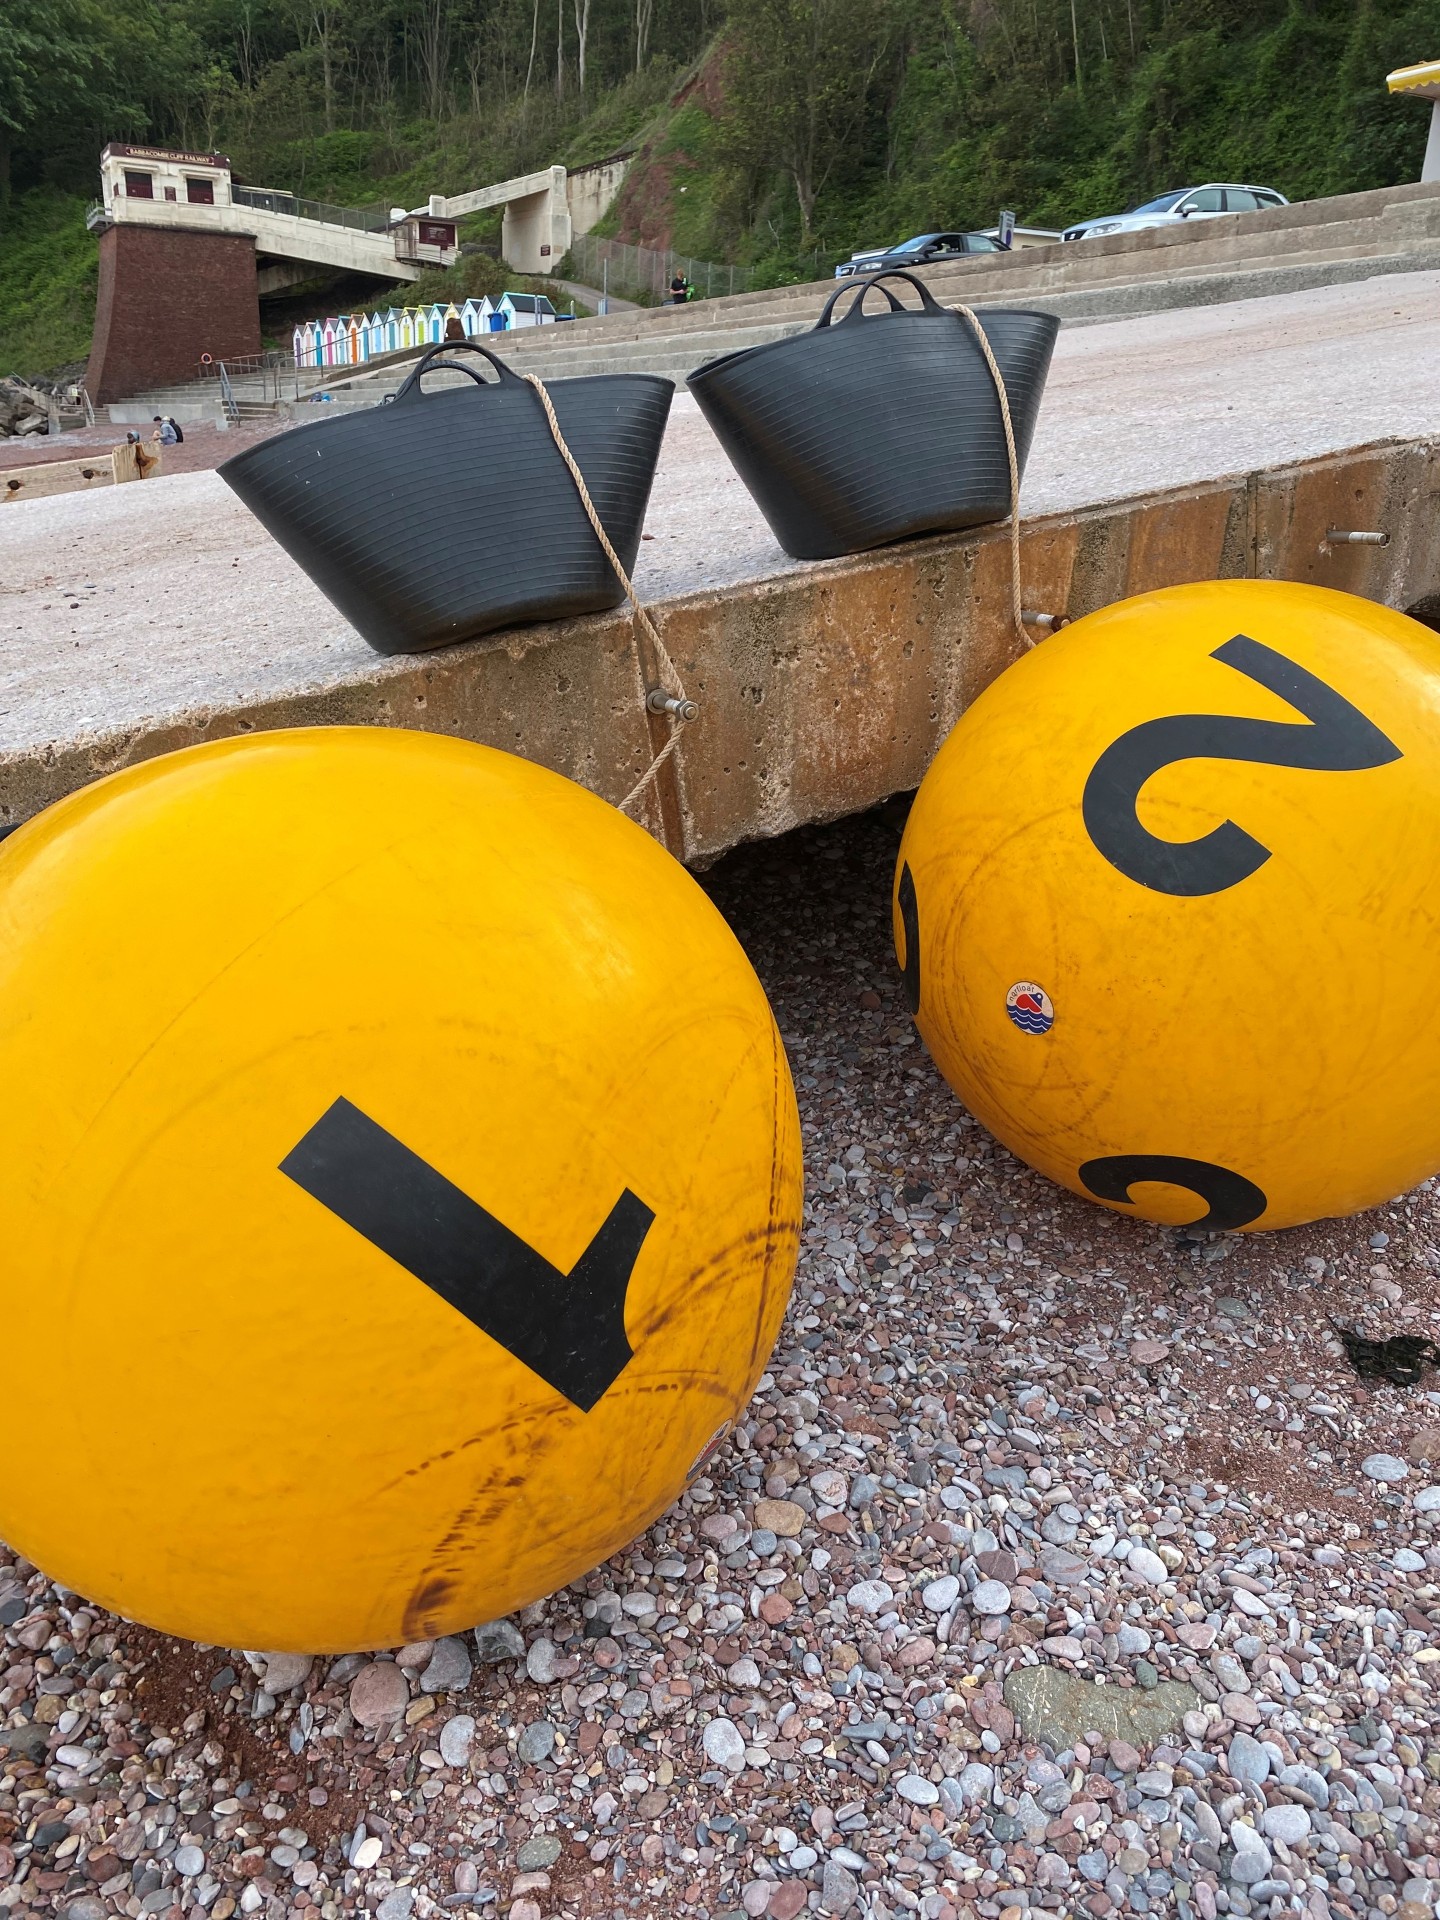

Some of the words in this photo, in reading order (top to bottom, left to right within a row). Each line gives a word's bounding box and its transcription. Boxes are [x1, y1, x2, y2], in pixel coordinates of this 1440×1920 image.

[169, 152, 184, 160] CLIFF
[184, 154, 210, 163] RAILWAY
[1082, 633, 1404, 897] 2
[277, 1095, 656, 1413] 1
